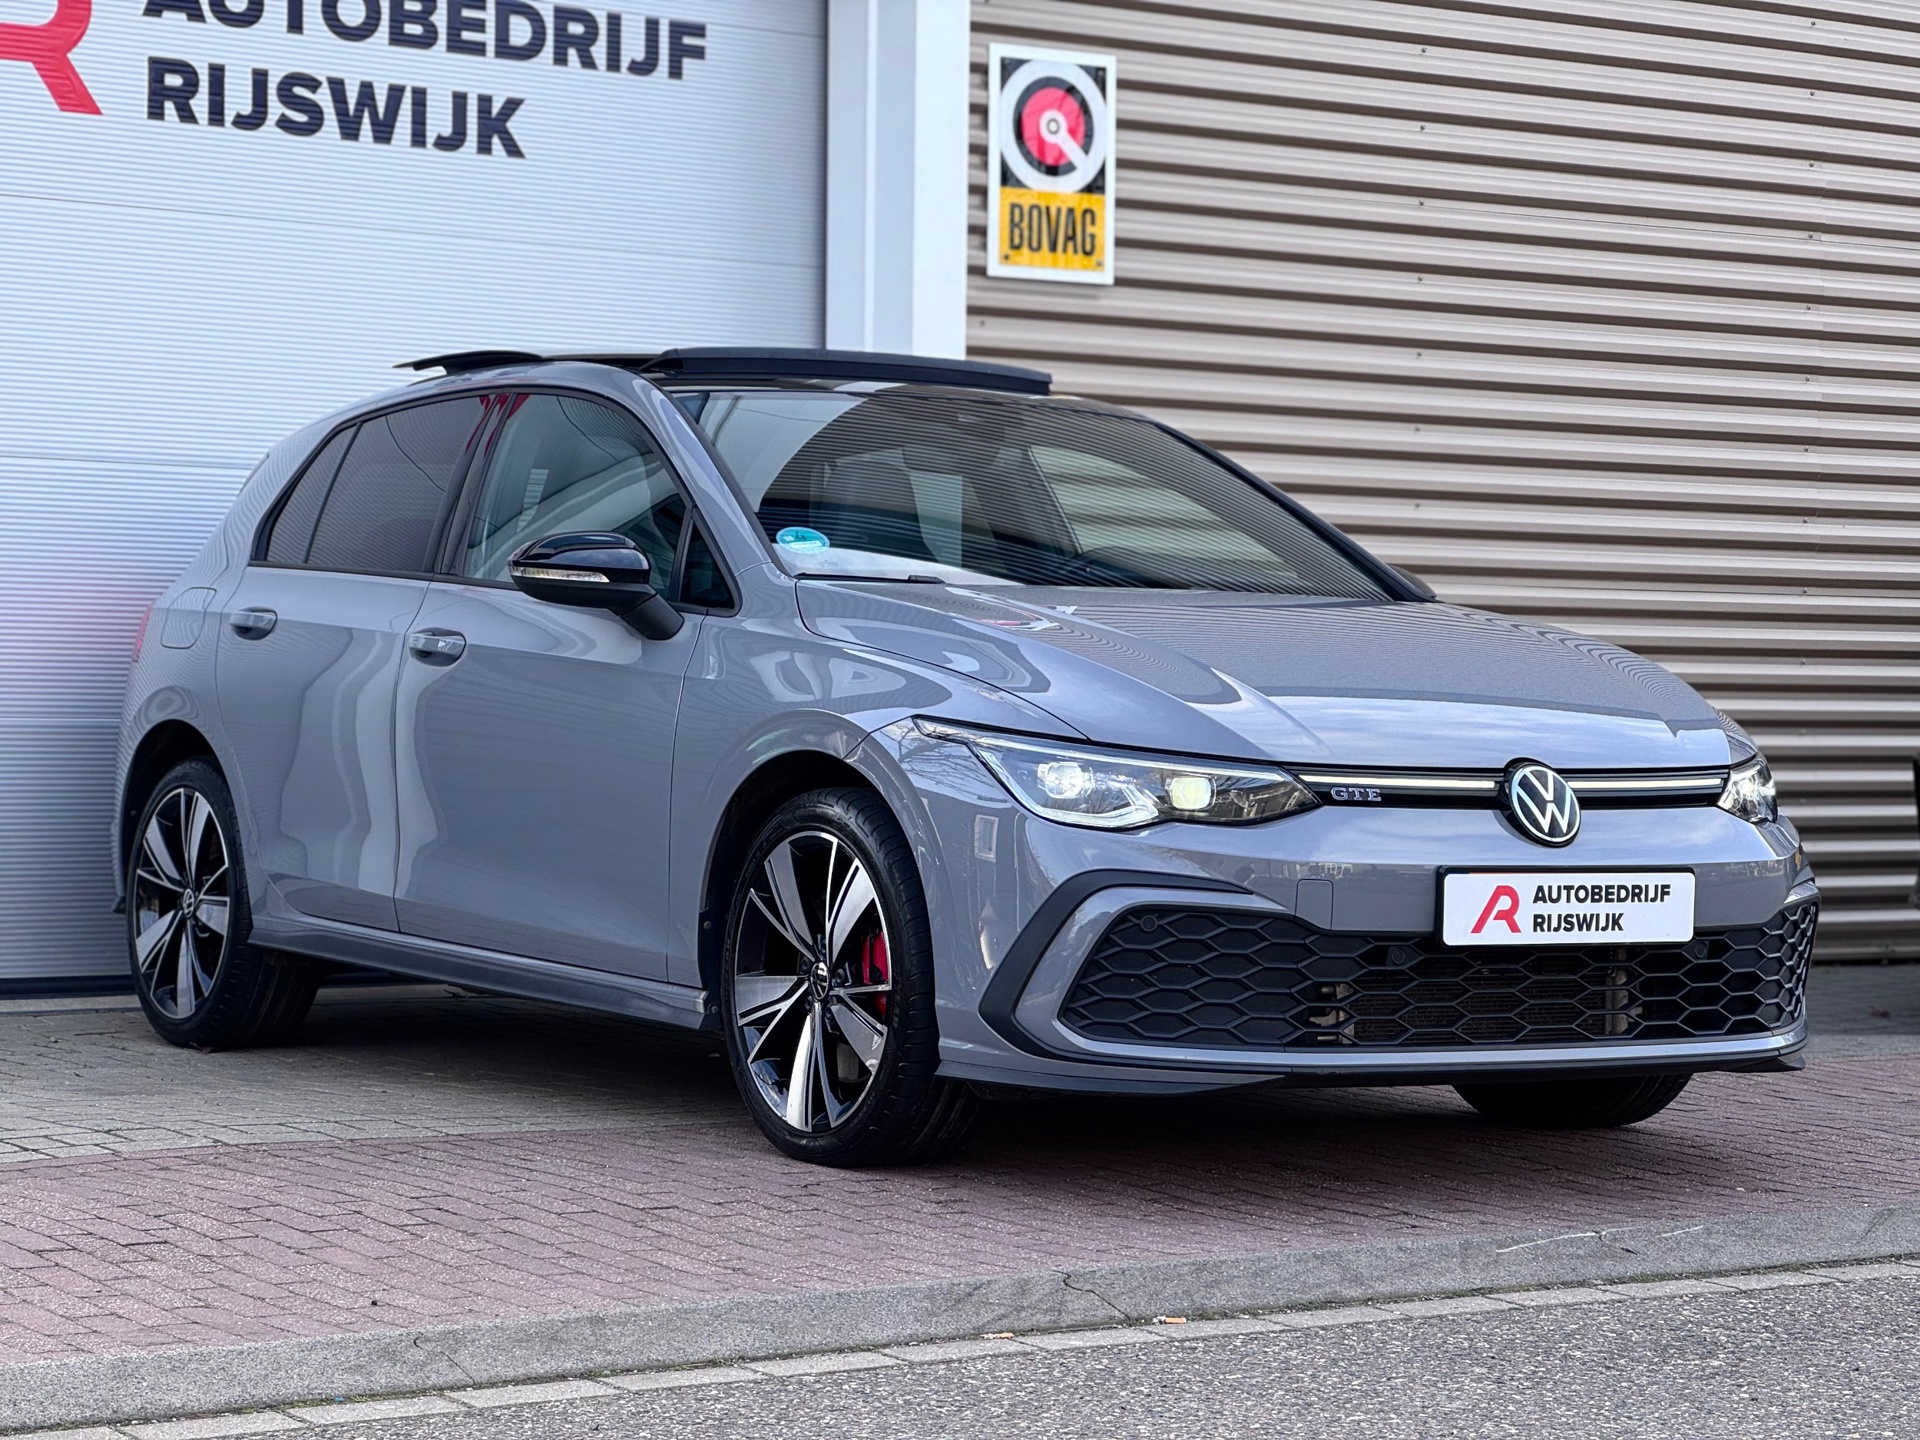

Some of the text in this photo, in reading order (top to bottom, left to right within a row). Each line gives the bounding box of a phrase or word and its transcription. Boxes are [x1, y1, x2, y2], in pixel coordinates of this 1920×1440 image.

[148, 56, 526, 159] RIJSWIJK
[1009, 203, 1096, 257] BOVAG
[1330, 787, 1382, 801] GTE
[1532, 884, 1671, 904] AUTOBEDRIJF
[1532, 912, 1625, 933] RIJSWIJK
